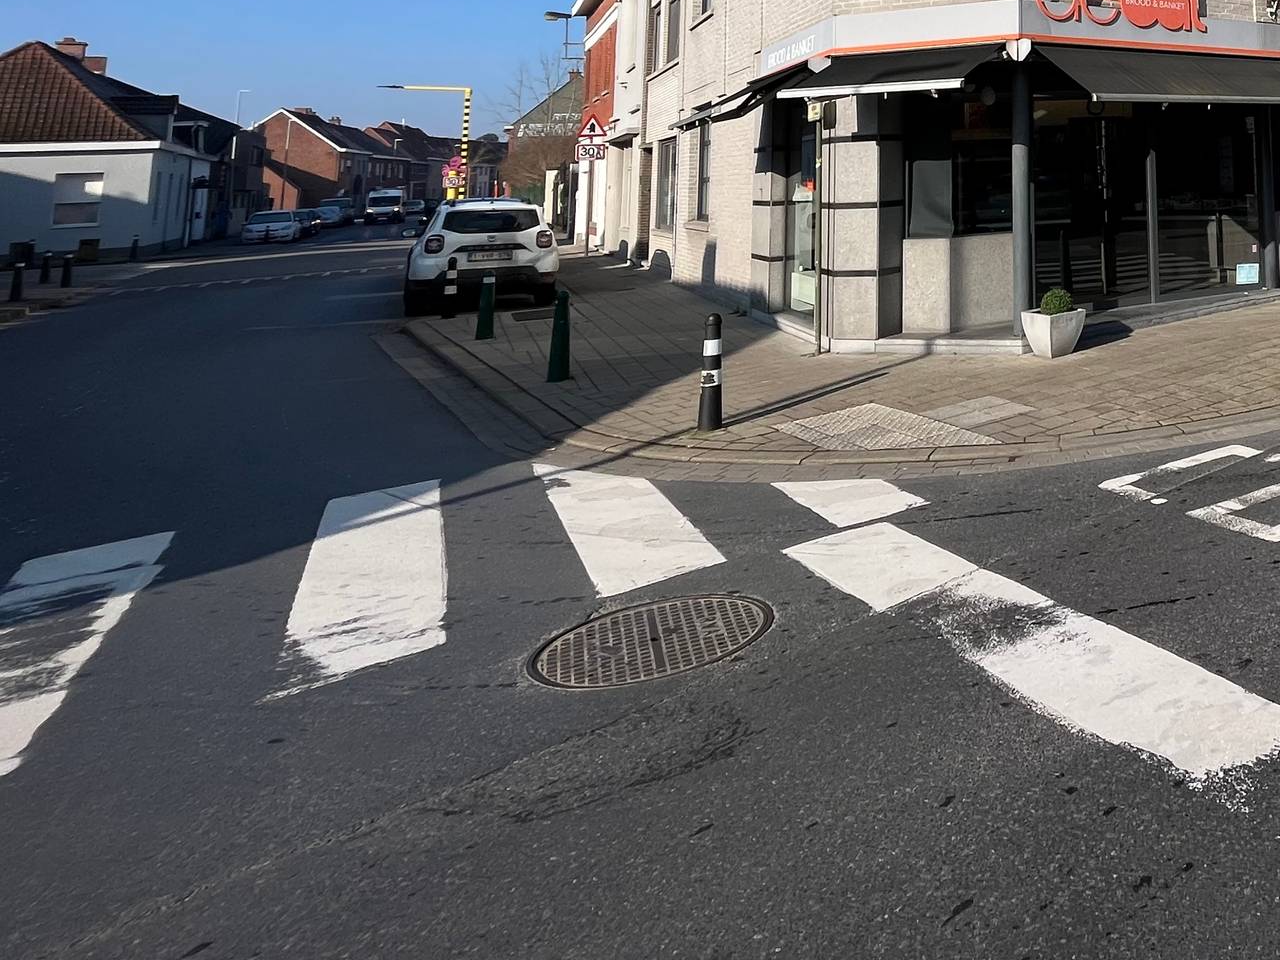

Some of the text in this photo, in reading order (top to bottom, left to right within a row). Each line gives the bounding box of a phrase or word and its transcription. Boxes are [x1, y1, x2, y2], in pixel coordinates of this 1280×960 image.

[1152, 0, 1159, 8] &
[1160, 1, 1185, 10] BANKET
[580, 146, 595, 157] 30
